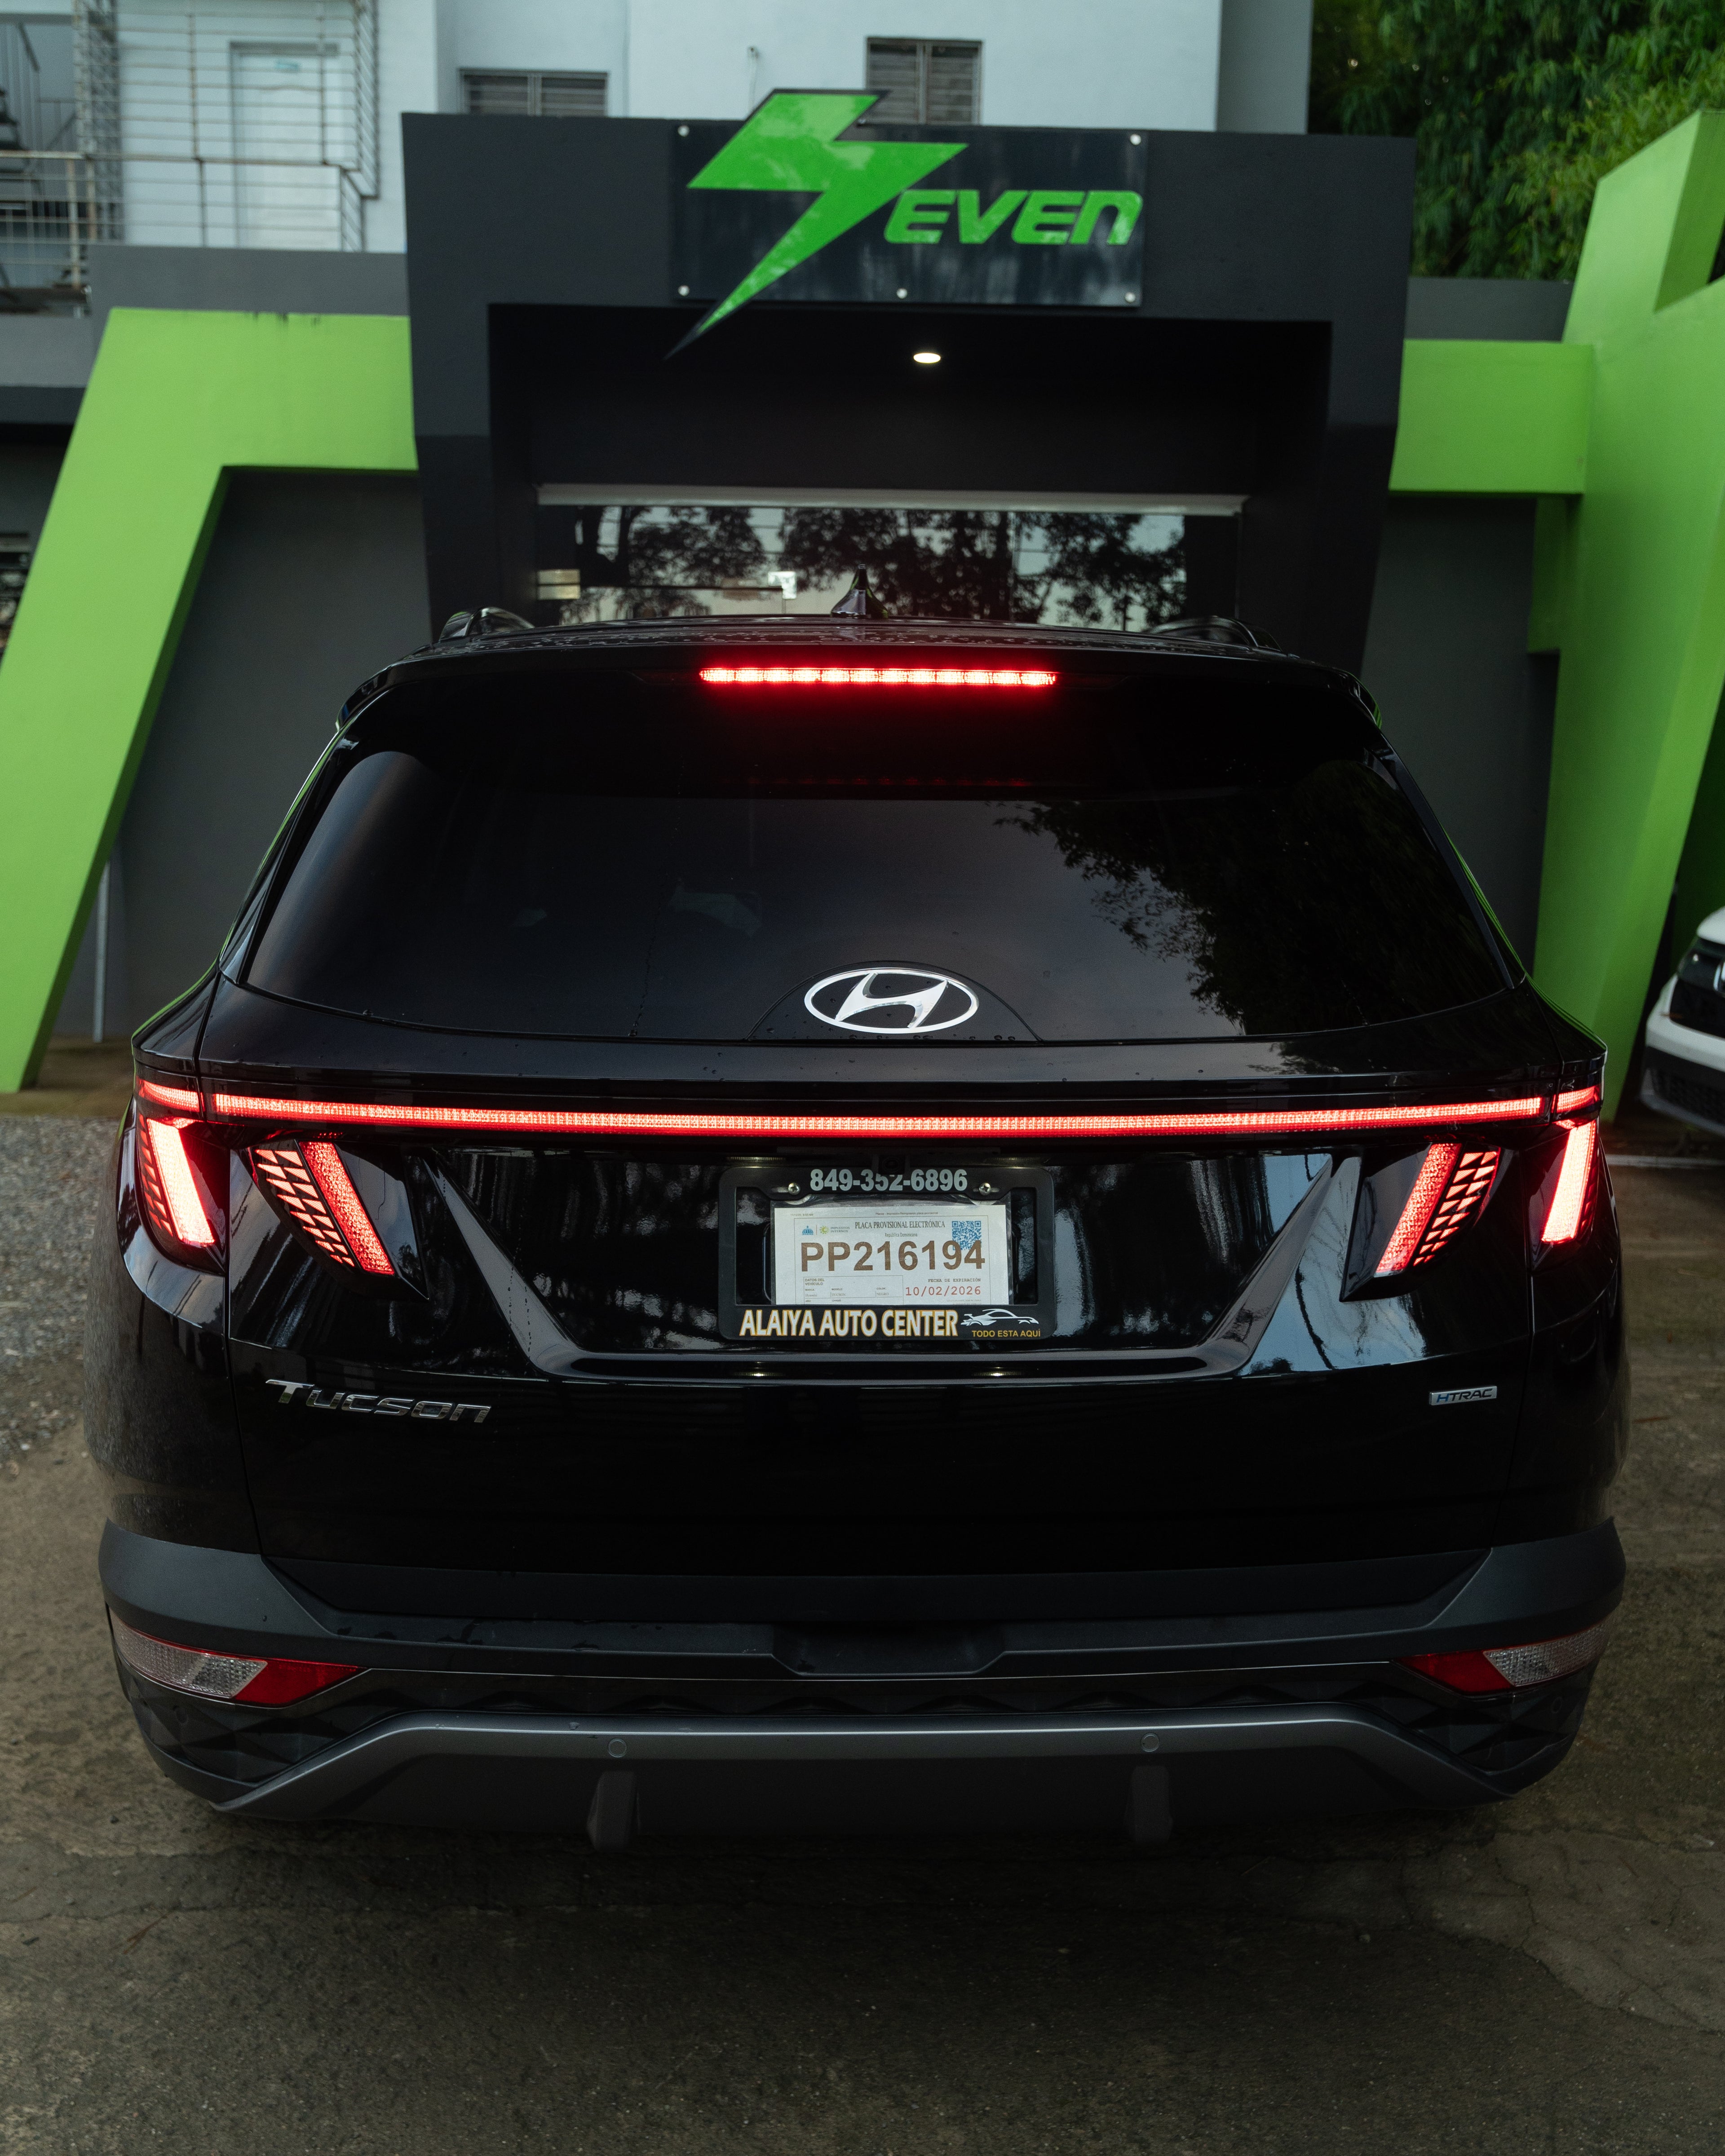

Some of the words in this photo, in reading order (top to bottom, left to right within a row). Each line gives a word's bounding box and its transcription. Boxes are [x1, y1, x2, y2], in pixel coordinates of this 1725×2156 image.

[810, 1169, 968, 1191] 849-352-6896
[909, 1219, 945, 1228] ELECTRÓNICA
[801, 1240, 985, 1272] PP216194
[906, 1286, 981, 1297] 10/02/2026
[739, 1309, 815, 1336] ALAIYA
[818, 1309, 877, 1336] AUTO
[881, 1309, 958, 1336] CENTER
[265, 1379, 491, 1423] TUCSON
[1437, 1388, 1493, 1403] HTRAC
